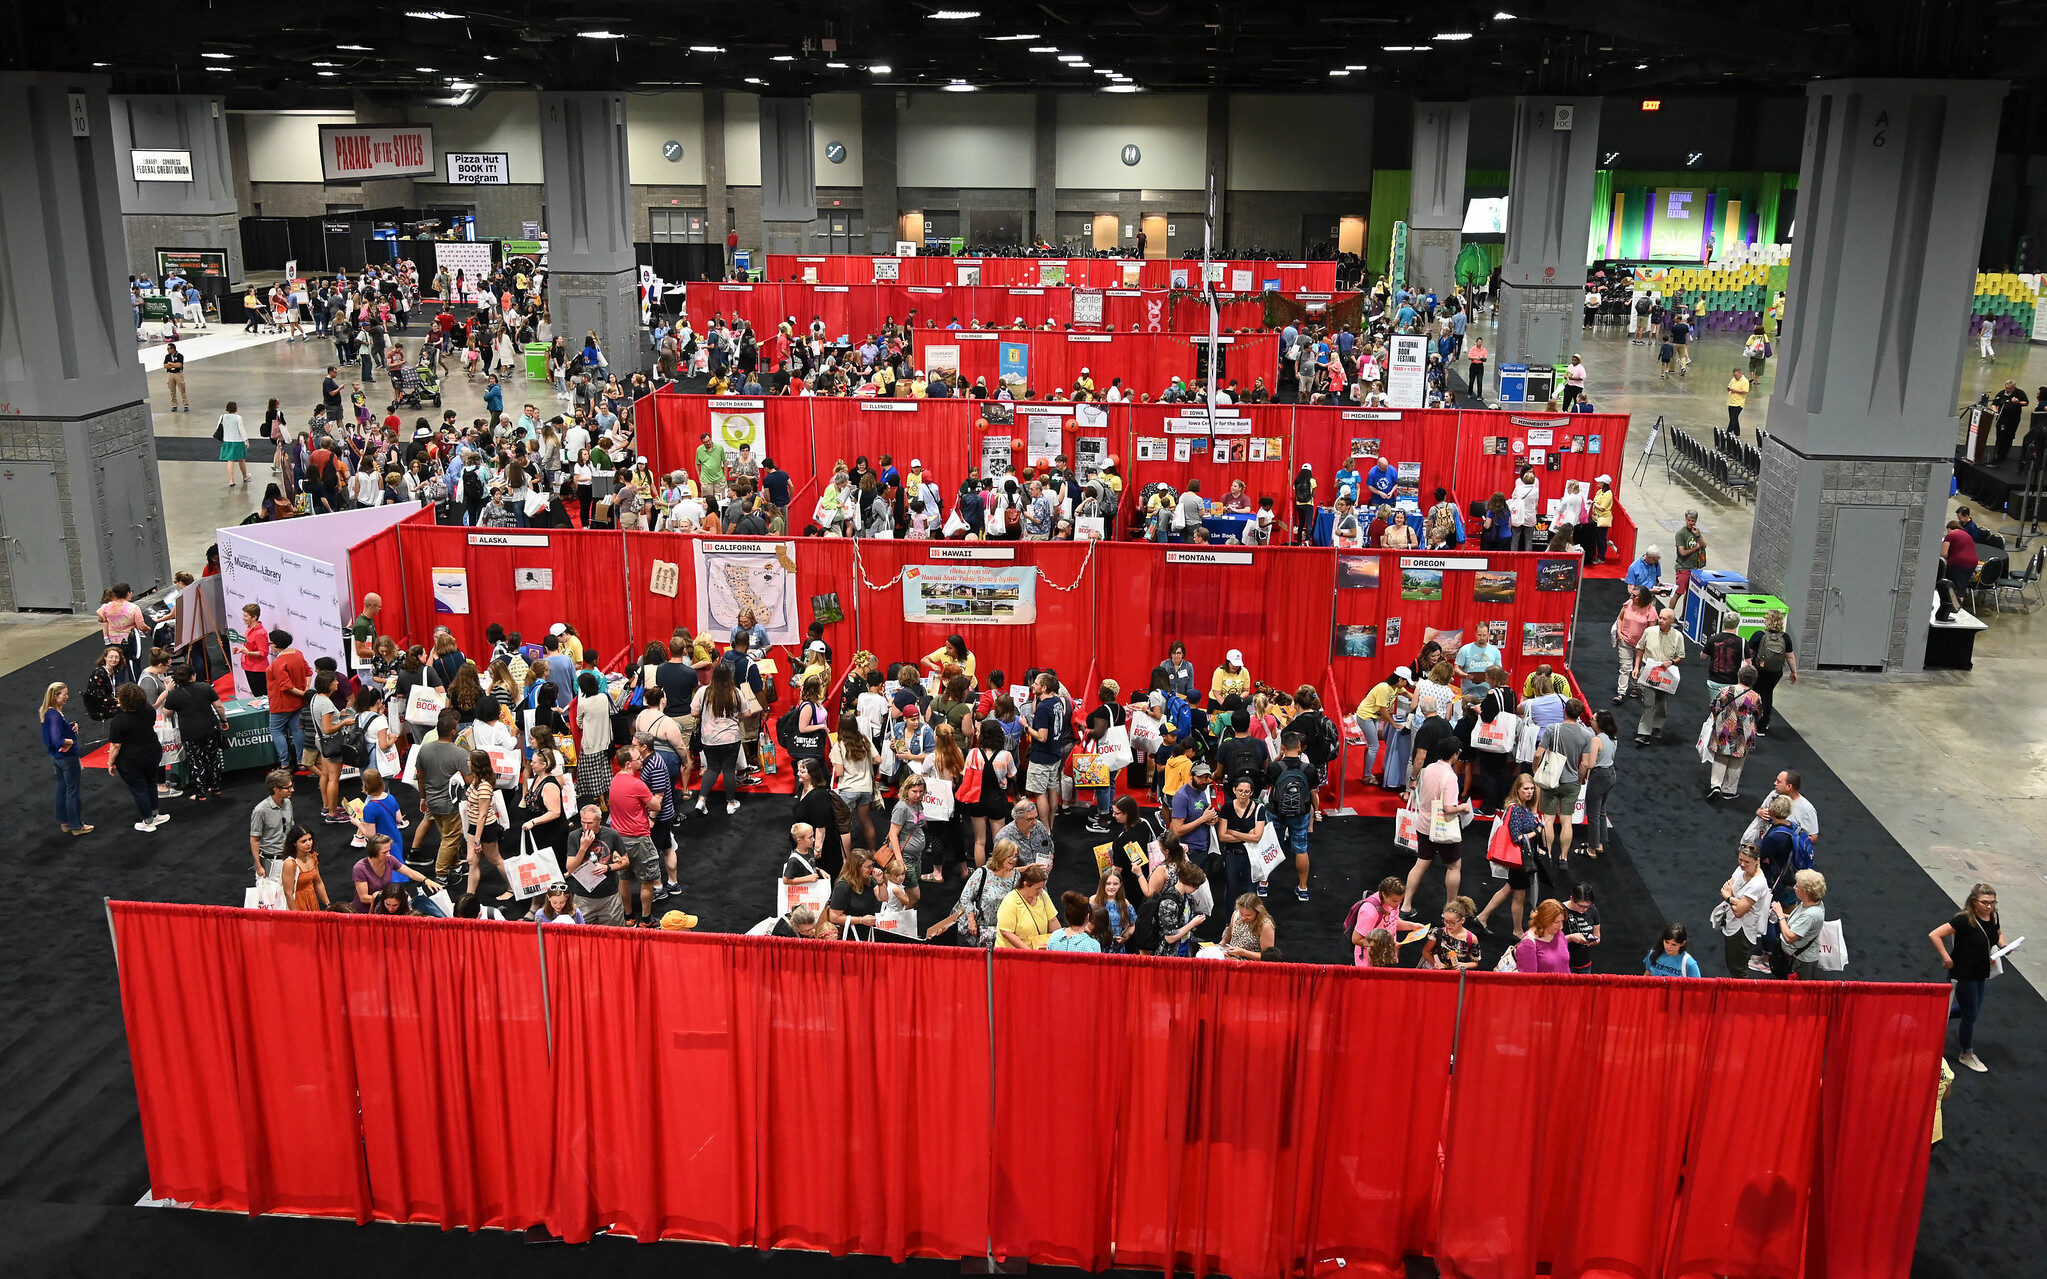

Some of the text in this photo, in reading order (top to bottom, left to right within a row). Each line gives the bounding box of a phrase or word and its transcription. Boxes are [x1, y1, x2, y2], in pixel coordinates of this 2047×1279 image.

[76, 98, 82, 112] A
[1642, 101, 1660, 110] EXIT
[1876, 110, 1889, 126] A
[75, 116, 86, 132] 10
[1873, 130, 1886, 147] 6
[334, 134, 424, 170] PARADE OF THE STATES
[455, 155, 499, 164] Pizza Hut
[136, 165, 189, 174] FEDERAL CREDIT UNION
[458, 164, 497, 172] BOOK IT!
[458, 174, 498, 184] Program
[1667, 210, 1690, 218] FESTIVAL
[1074, 294, 1102, 303] Center
[1075, 304, 1102, 312] for the
[1074, 312, 1101, 322] Book
[234, 557, 257, 572] Museum
[262, 565, 282, 582] Library
[416, 702, 438, 711] BOOK
[1134, 728, 1148, 738] BOOK
[1478, 737, 1492, 745] LIBRARY
[1264, 848, 1279, 864] BOOK
[539, 873, 551, 882] 2019
[523, 885, 542, 895] LIBRARY
[788, 886, 809, 895] NATIONAL
[807, 902, 820, 911] 2019
